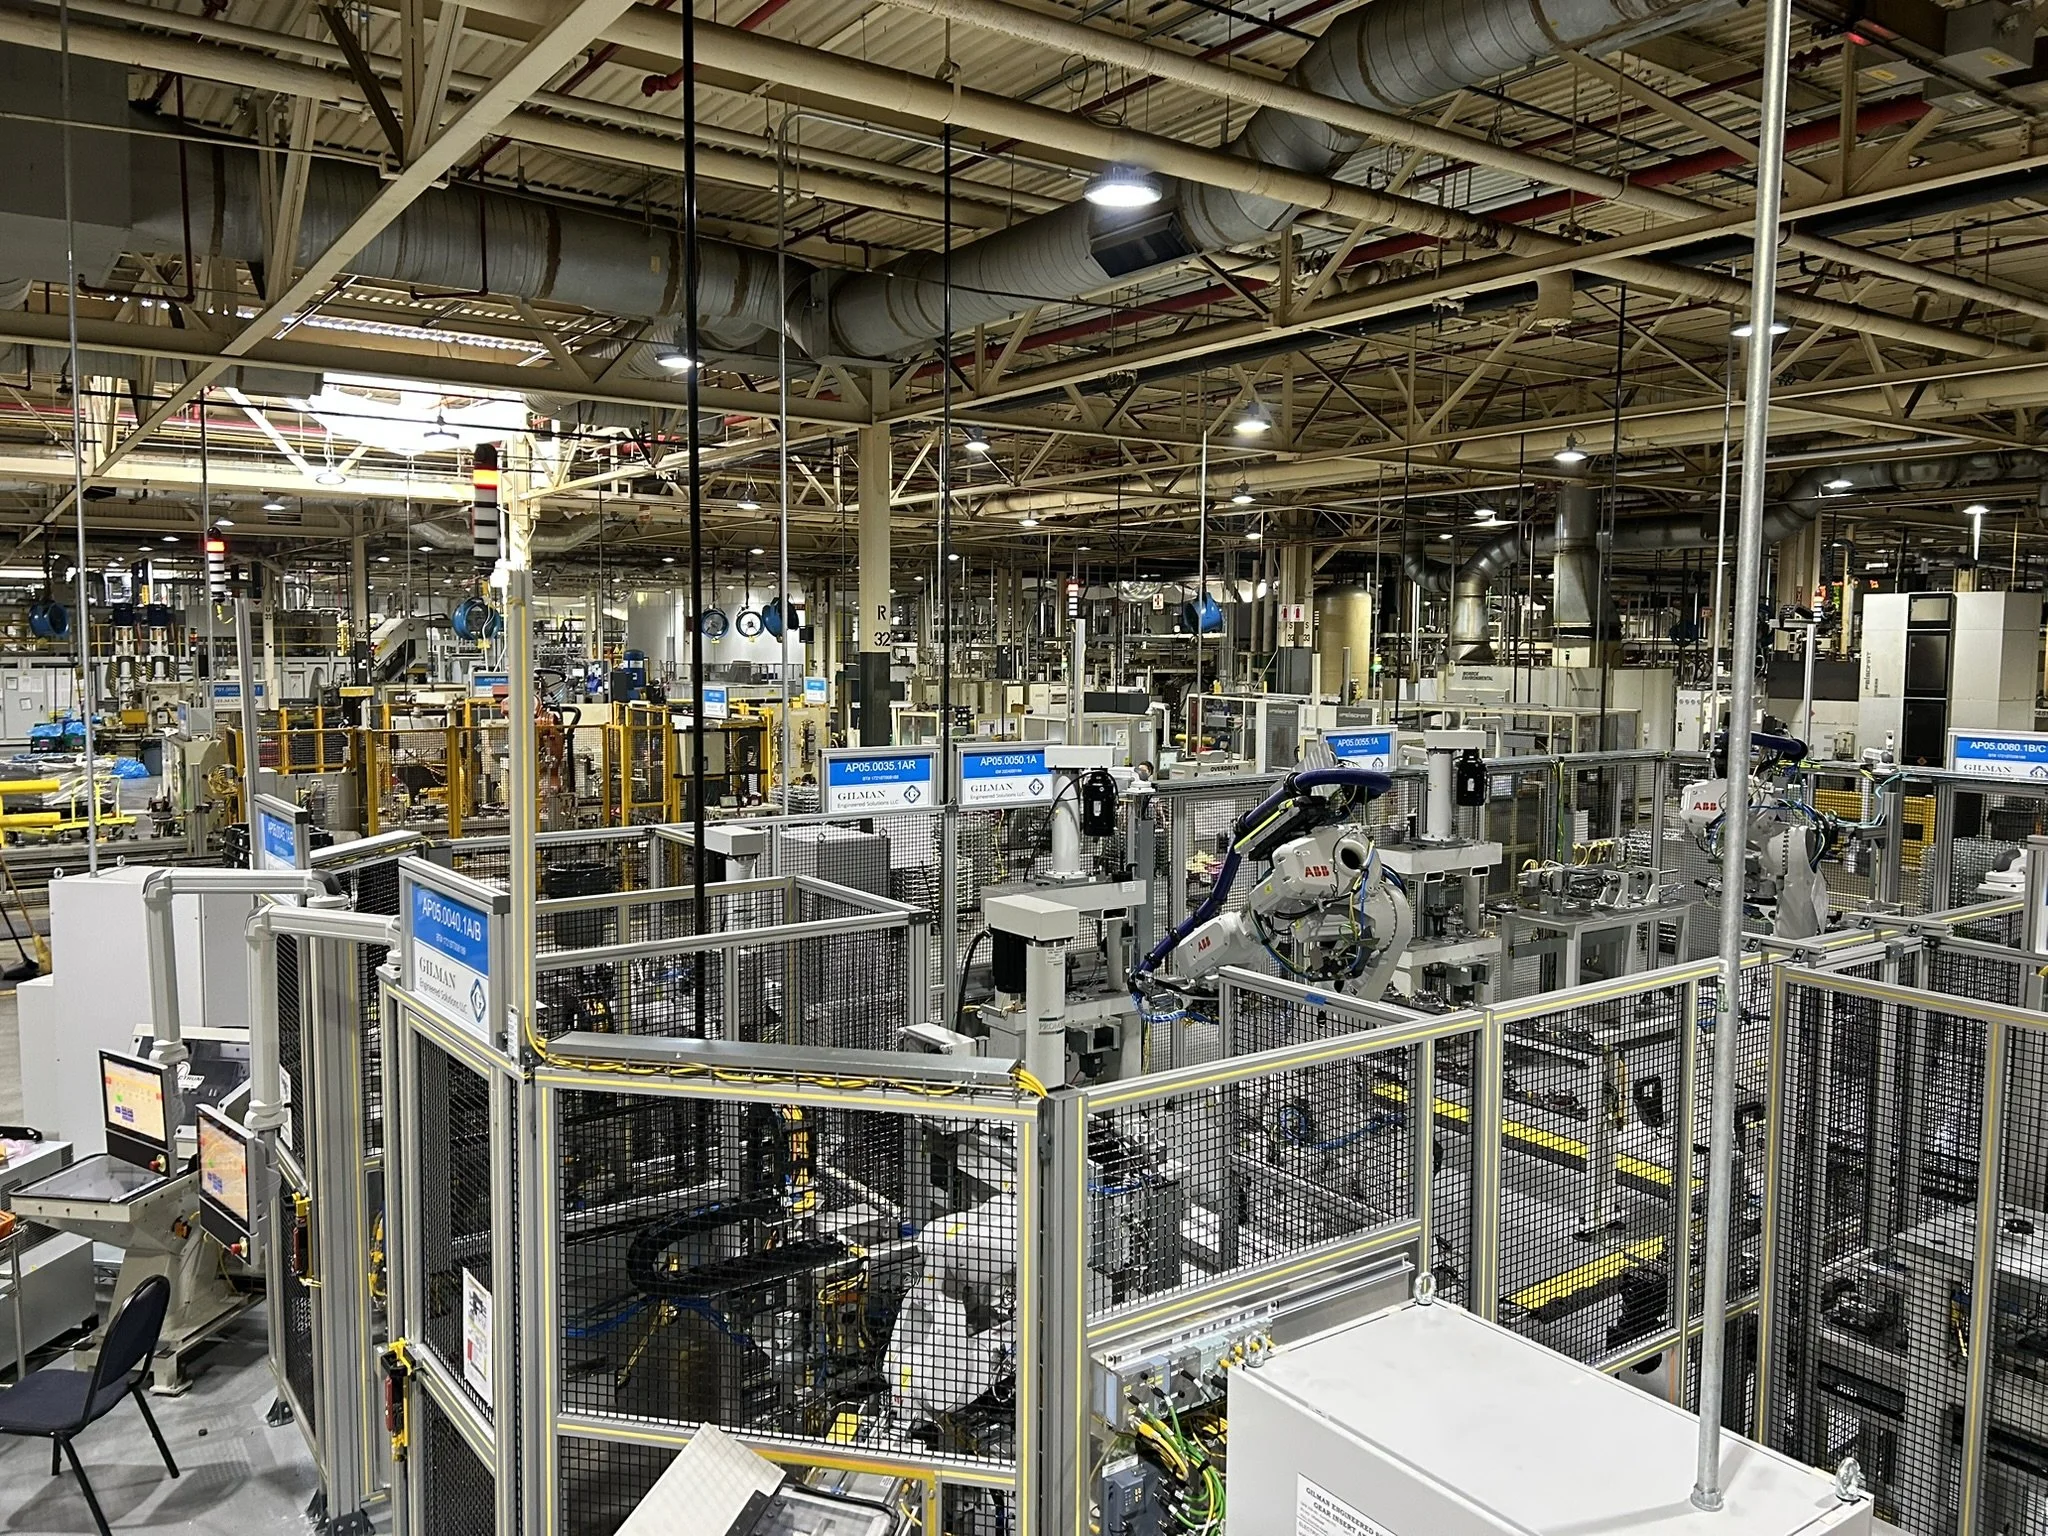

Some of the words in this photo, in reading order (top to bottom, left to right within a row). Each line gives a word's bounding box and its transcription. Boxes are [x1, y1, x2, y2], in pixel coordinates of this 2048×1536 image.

[877, 604, 886, 620] R
[873, 631, 890, 646] 32
[1970, 741, 2046, 753] AP05.0080.1B/C
[845, 760, 916, 773] AP05.0035.1AR
[980, 755, 1037, 767] AP05.0050.1A
[1964, 763, 2012, 773] GILMAN
[970, 783, 1013, 793] GILMAN
[837, 790, 886, 801] GILMAN
[1694, 802, 1717, 811] ABB
[1304, 865, 1330, 878] ABB
[422, 896, 481, 942] AP05.0040.1A/B
[1198, 936, 1211, 952] ABB
[419, 956, 456, 991] GILMAN
[1305, 1487, 1330, 1507] GILMAN
[1331, 1503, 1374, 1535] ENGINEERED
[1313, 1502, 1331, 1518] GEAR
[1332, 1514, 1357, 1534] INSERT
